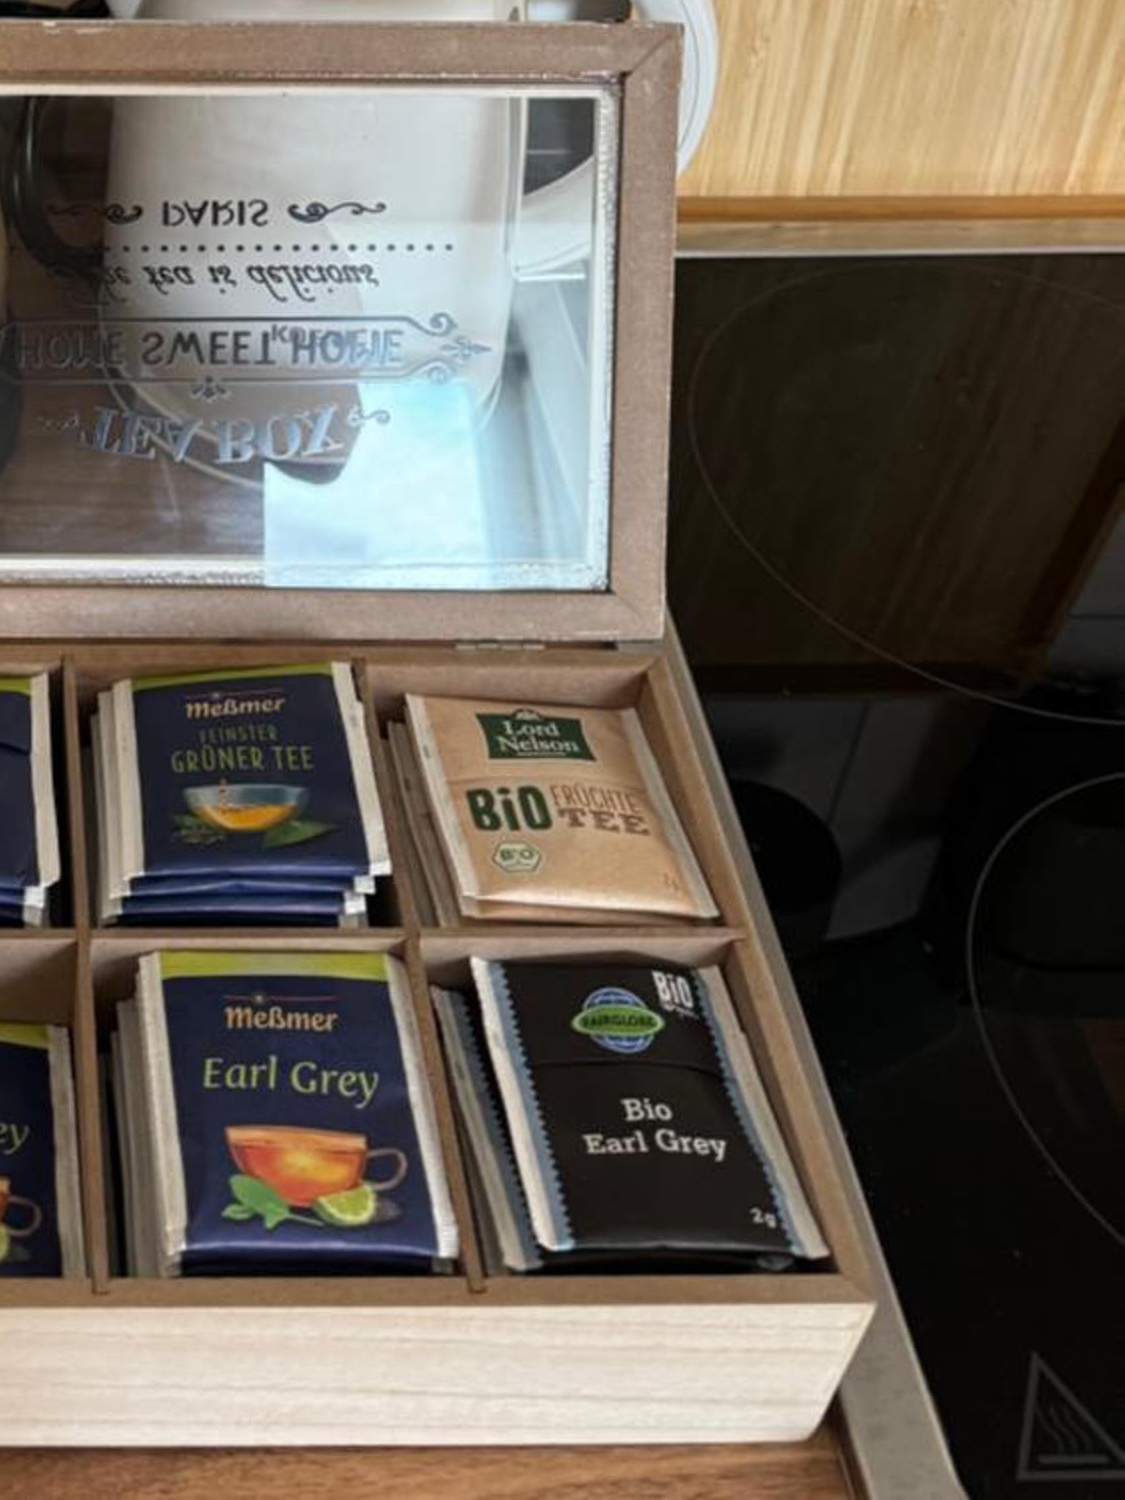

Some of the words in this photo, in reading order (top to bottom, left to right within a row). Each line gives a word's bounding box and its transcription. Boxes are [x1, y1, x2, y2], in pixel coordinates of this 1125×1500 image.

[199, 723, 278, 744] FEINSTER
[501, 719, 561, 737] Lord
[496, 735, 581, 754] Nelson
[171, 744, 264, 773] GRÜNER
[271, 746, 315, 770] TEE
[557, 808, 651, 836] TEE
[202, 1058, 278, 1090] Earl
[290, 1061, 378, 1107] Grey
[621, 1098, 673, 1123] Bio
[582, 1130, 649, 1156] Earl
[654, 1129, 728, 1162] Grey
